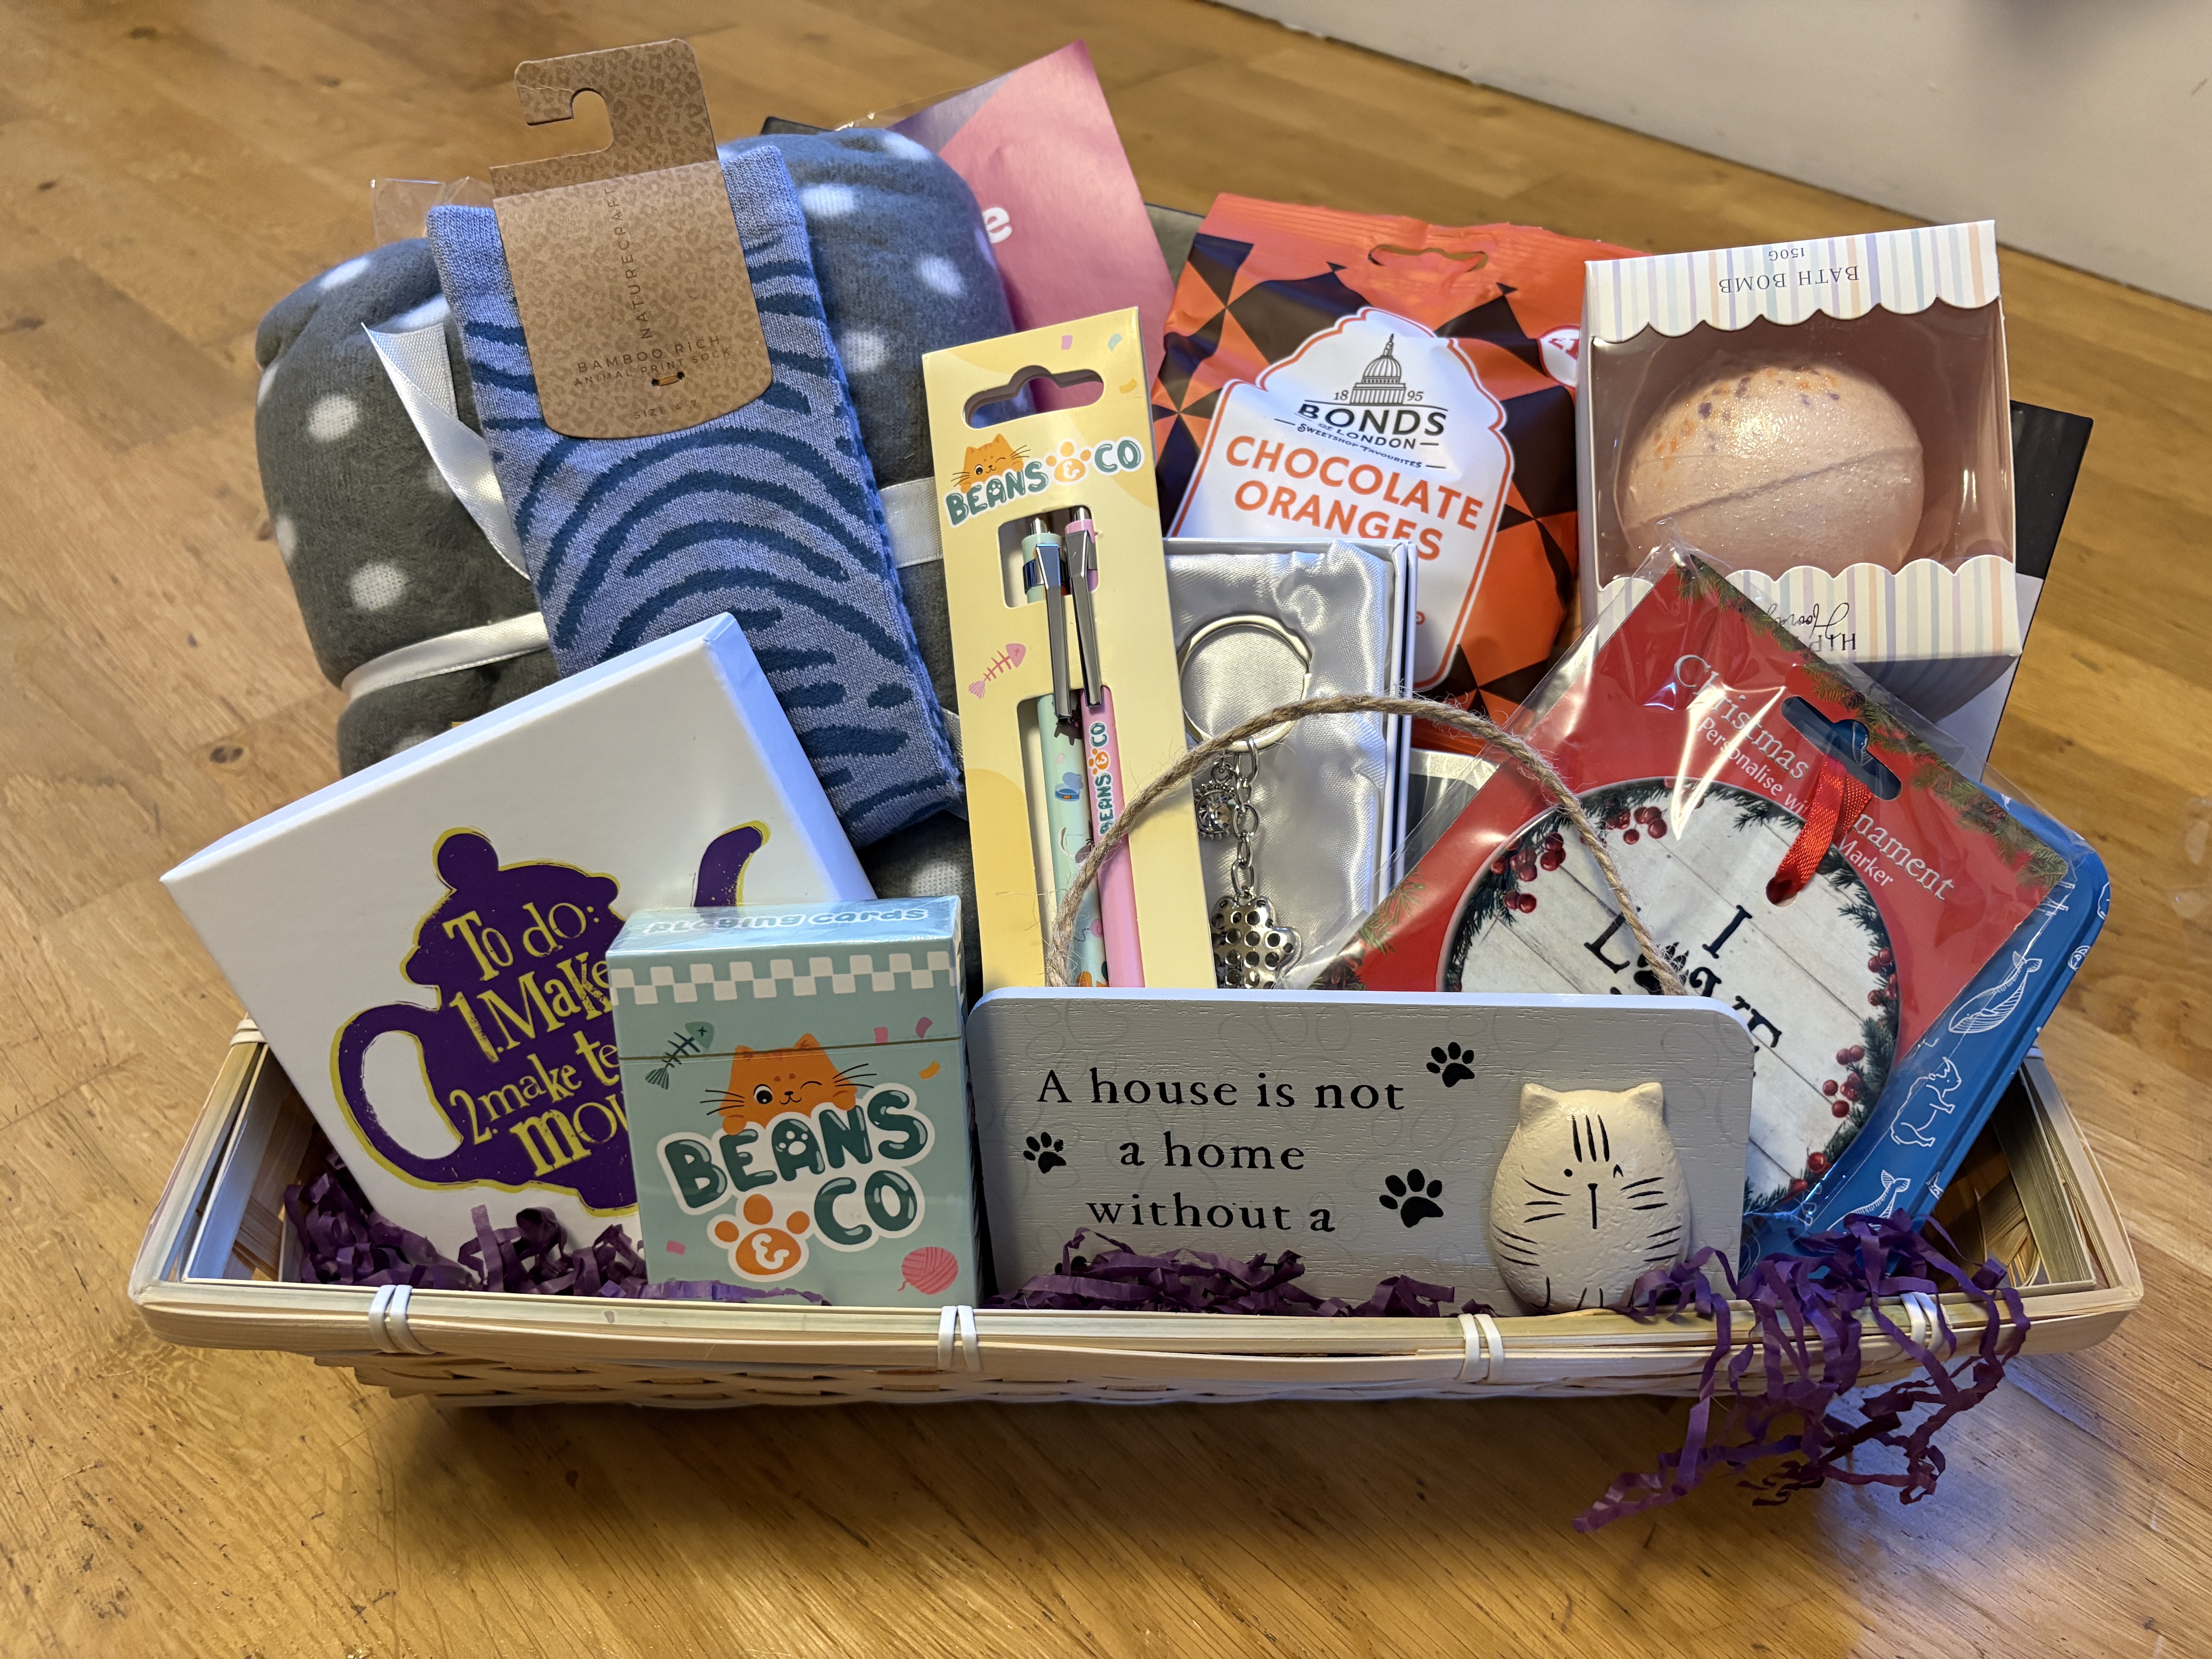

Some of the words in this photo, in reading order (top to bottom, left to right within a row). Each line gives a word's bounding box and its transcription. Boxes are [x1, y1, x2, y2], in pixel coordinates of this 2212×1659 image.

[605, 188, 653, 340] NATURECRAFT
[1769, 248, 1805, 261] 150G
[1719, 273, 1786, 293] BOMB
[1797, 266, 1859, 286] BATH
[574, 370, 633, 386] ANIMAL
[641, 359, 684, 374] PRINT
[692, 348, 731, 363] SOCK
[578, 349, 662, 373] BAMBOO
[675, 335, 720, 355] RICH
[635, 407, 667, 419] SIZE
[1333, 391, 1348, 402] 18
[1406, 390, 1424, 402] 95
[1297, 404, 1447, 436] BONDS
[1337, 429, 1416, 449] LONDON
[945, 461, 1048, 525] BEANS
[1094, 440, 1141, 472] CO
[1226, 436, 1483, 531] CHOCOLATE
[1234, 480, 1443, 561] ORANGES
[1090, 723, 1107, 747] CO
[1697, 717, 1788, 797] Personalise
[1674, 654, 1809, 780] Christmas
[1853, 812, 1954, 901] nament
[811, 908, 929, 925] cards
[443, 911, 513, 981] To
[522, 902, 600, 957] do:
[1037, 1069, 1072, 1103] A
[1089, 1067, 1237, 1107] house
[1257, 1072, 1295, 1108] is
[1314, 1082, 1405, 1110] not
[665, 1090, 928, 1209] BEANS
[1119, 1141, 1145, 1167] a
[1163, 1131, 1305, 1170] home
[814, 1170, 918, 1245] CO
[1086, 1192, 1291, 1230] without
[1310, 1206, 1336, 1232] a
